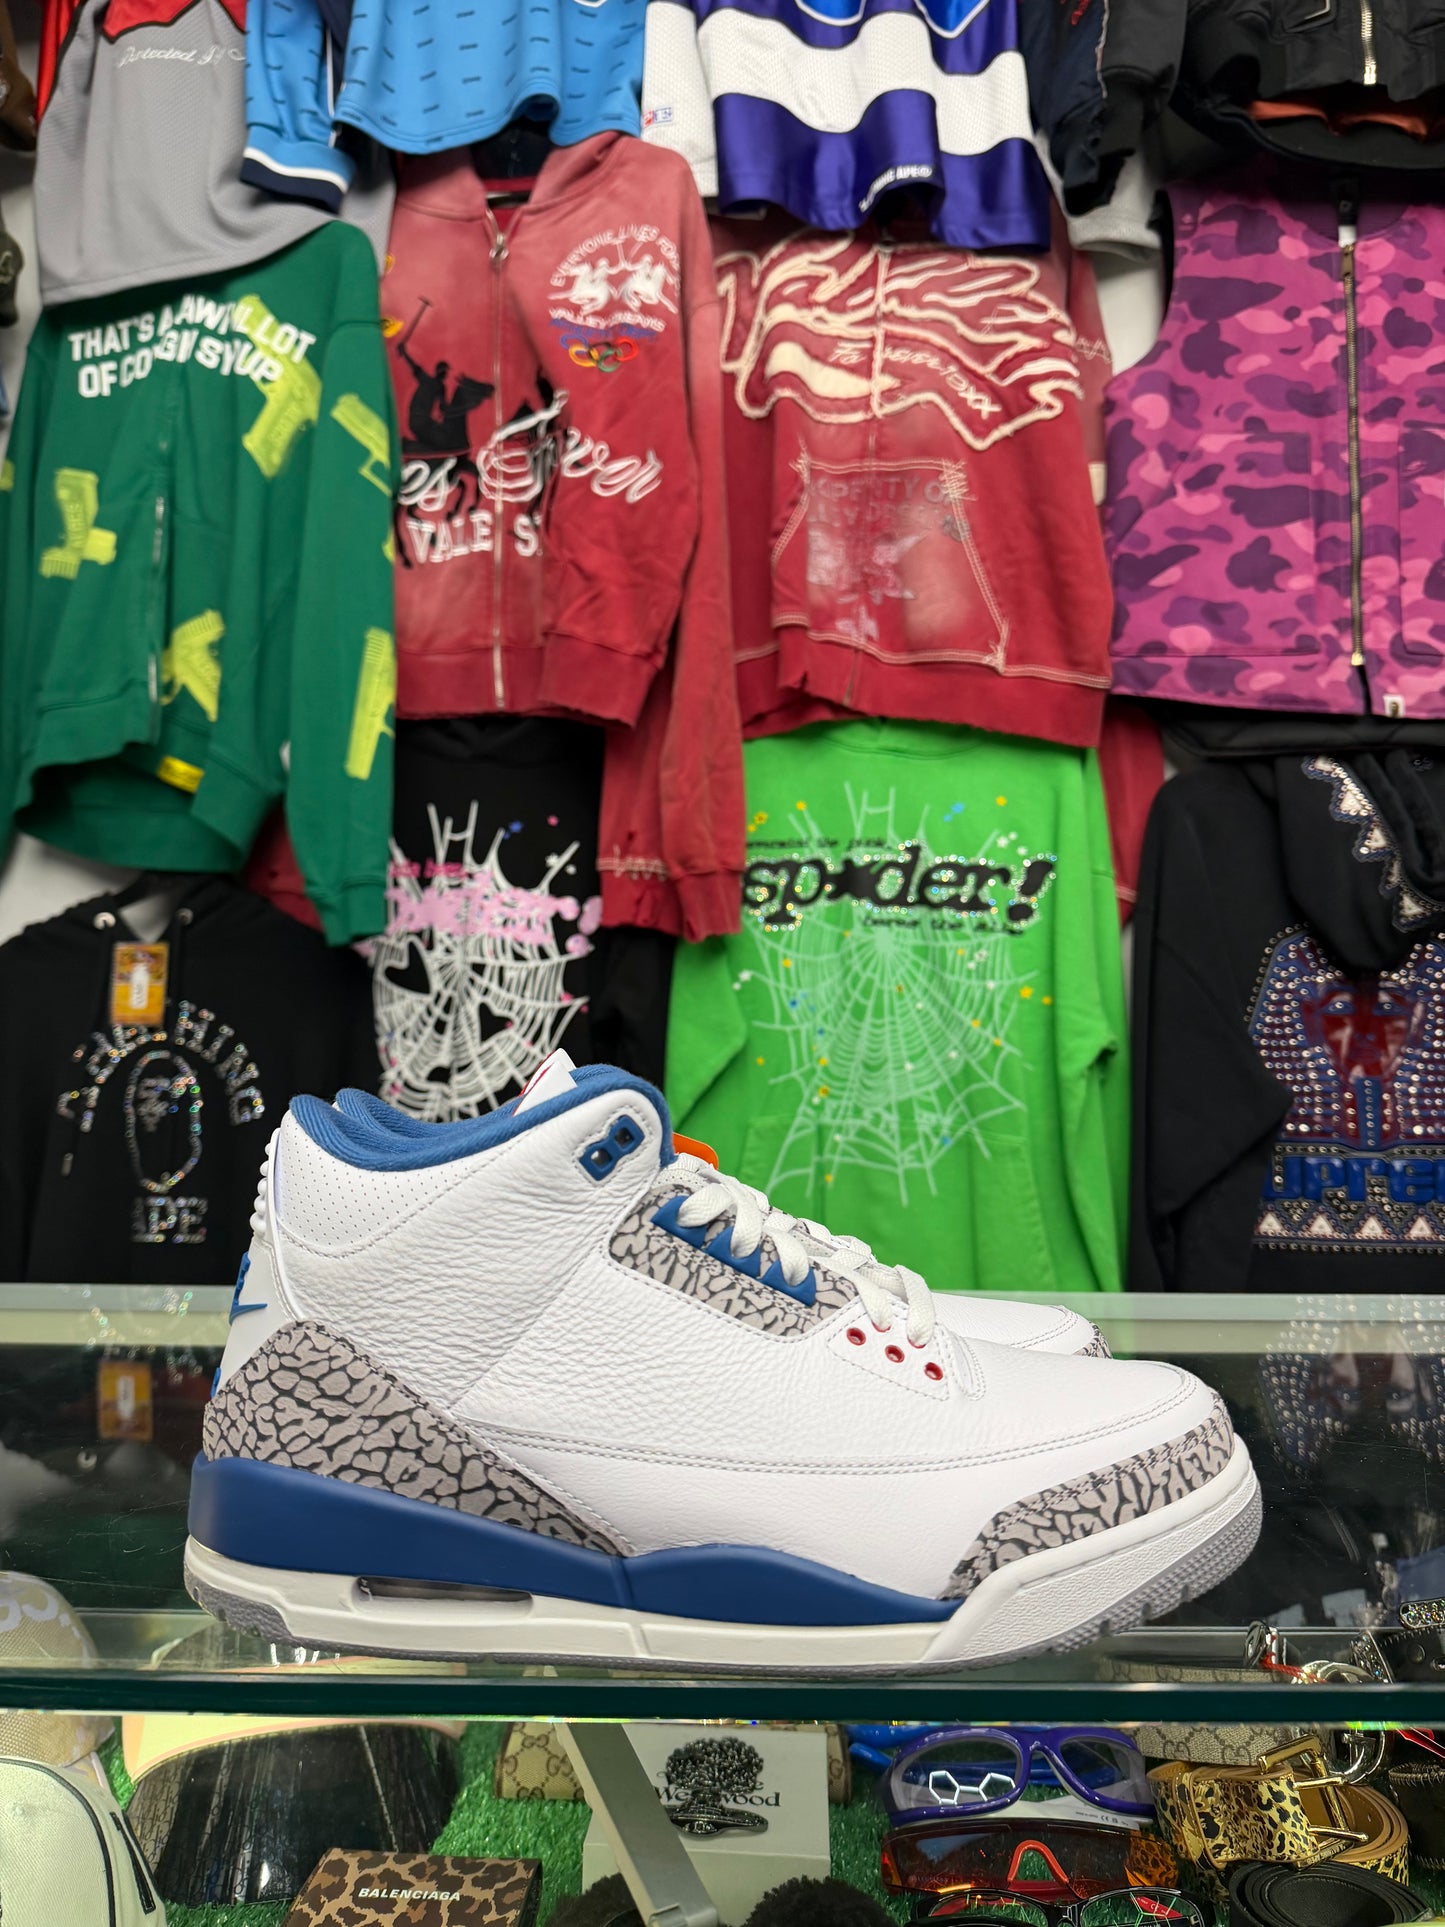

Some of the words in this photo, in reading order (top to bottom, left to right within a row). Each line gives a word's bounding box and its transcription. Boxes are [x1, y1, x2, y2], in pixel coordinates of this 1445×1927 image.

[68, 312, 155, 362] THAT'S
[175, 293, 253, 336] AWL
[255, 314, 317, 365] LOT
[78, 360, 118, 399] OF
[119, 327, 200, 388] COGH
[195, 334, 284, 382] SYUP
[654, 1785, 781, 1807] Wewood
[358, 1887, 461, 1901] BALENCIAGA
